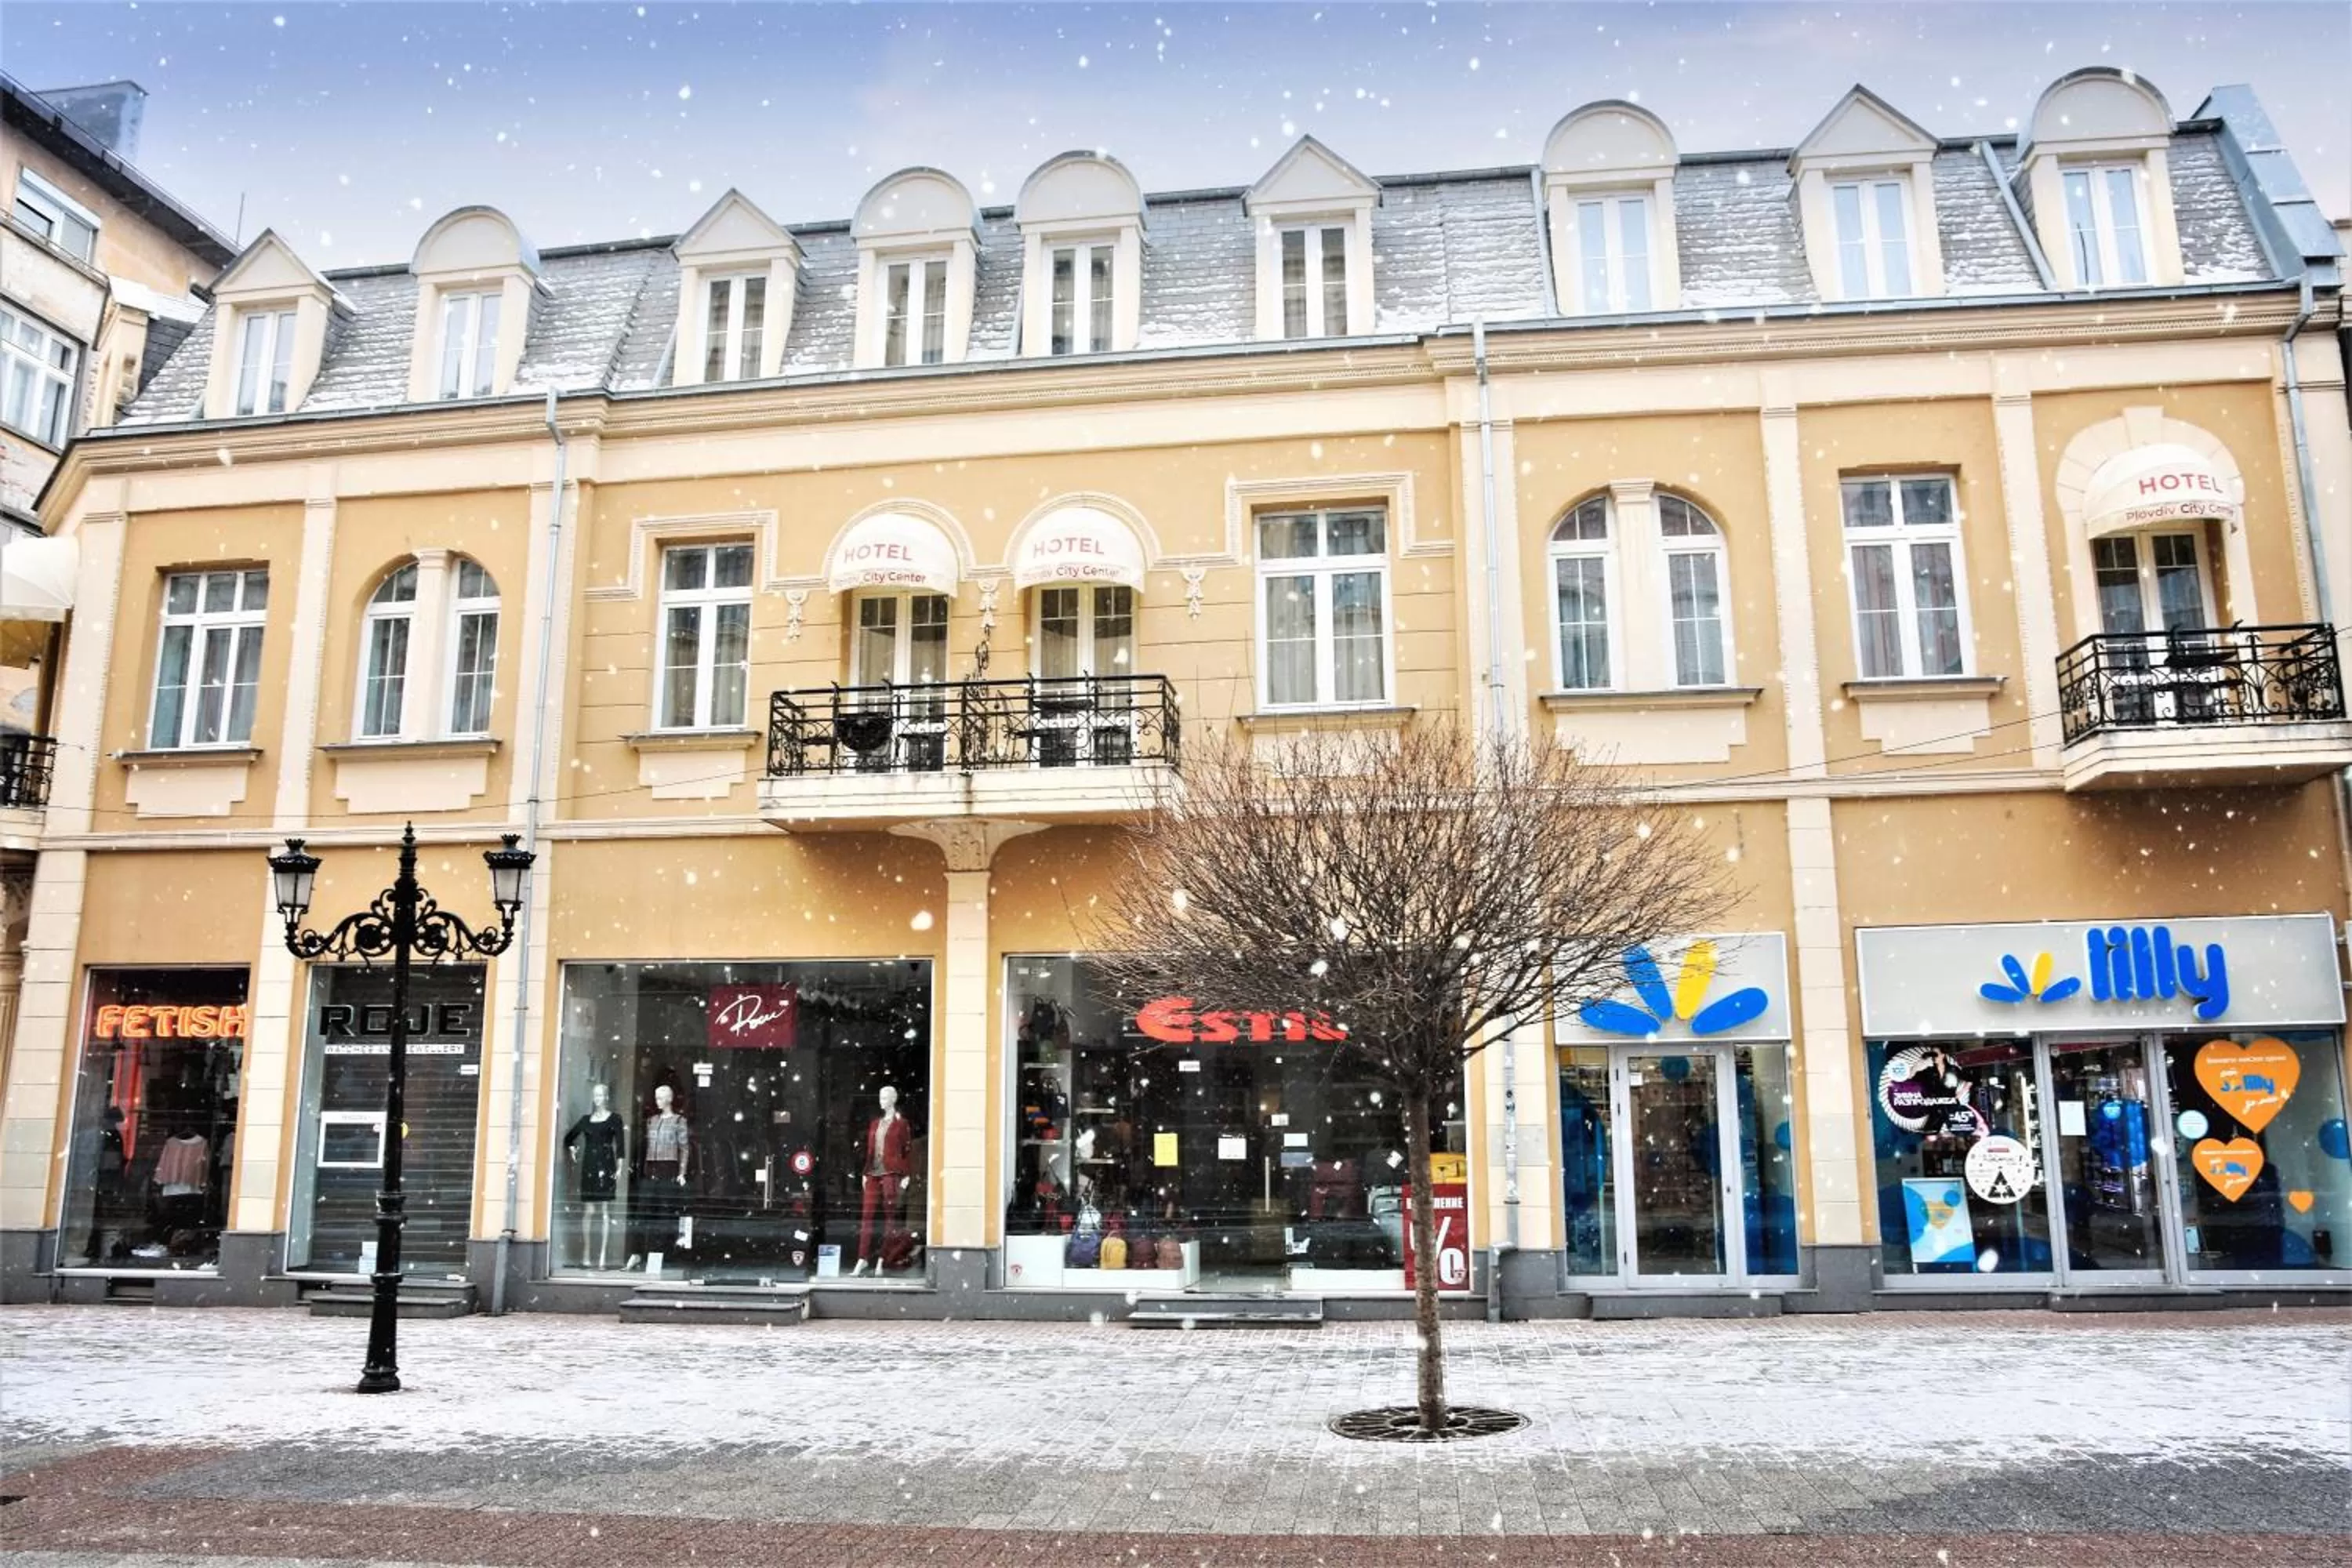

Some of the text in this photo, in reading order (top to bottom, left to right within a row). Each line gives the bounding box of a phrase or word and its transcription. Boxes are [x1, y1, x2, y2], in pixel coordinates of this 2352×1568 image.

[2139, 474, 2223, 495] HOTEL
[2125, 506, 2176, 521] Plovdiv
[2180, 503, 2205, 514] City
[844, 543, 913, 564] HOTEL
[1033, 537, 1105, 558] HOTEL
[863, 572, 885, 584] City
[888, 572, 927, 583] Center
[1056, 565, 1080, 578] City
[2084, 925, 2230, 1019] lilly
[96, 1004, 247, 1038] FETISH
[320, 1004, 472, 1036] ROJE
